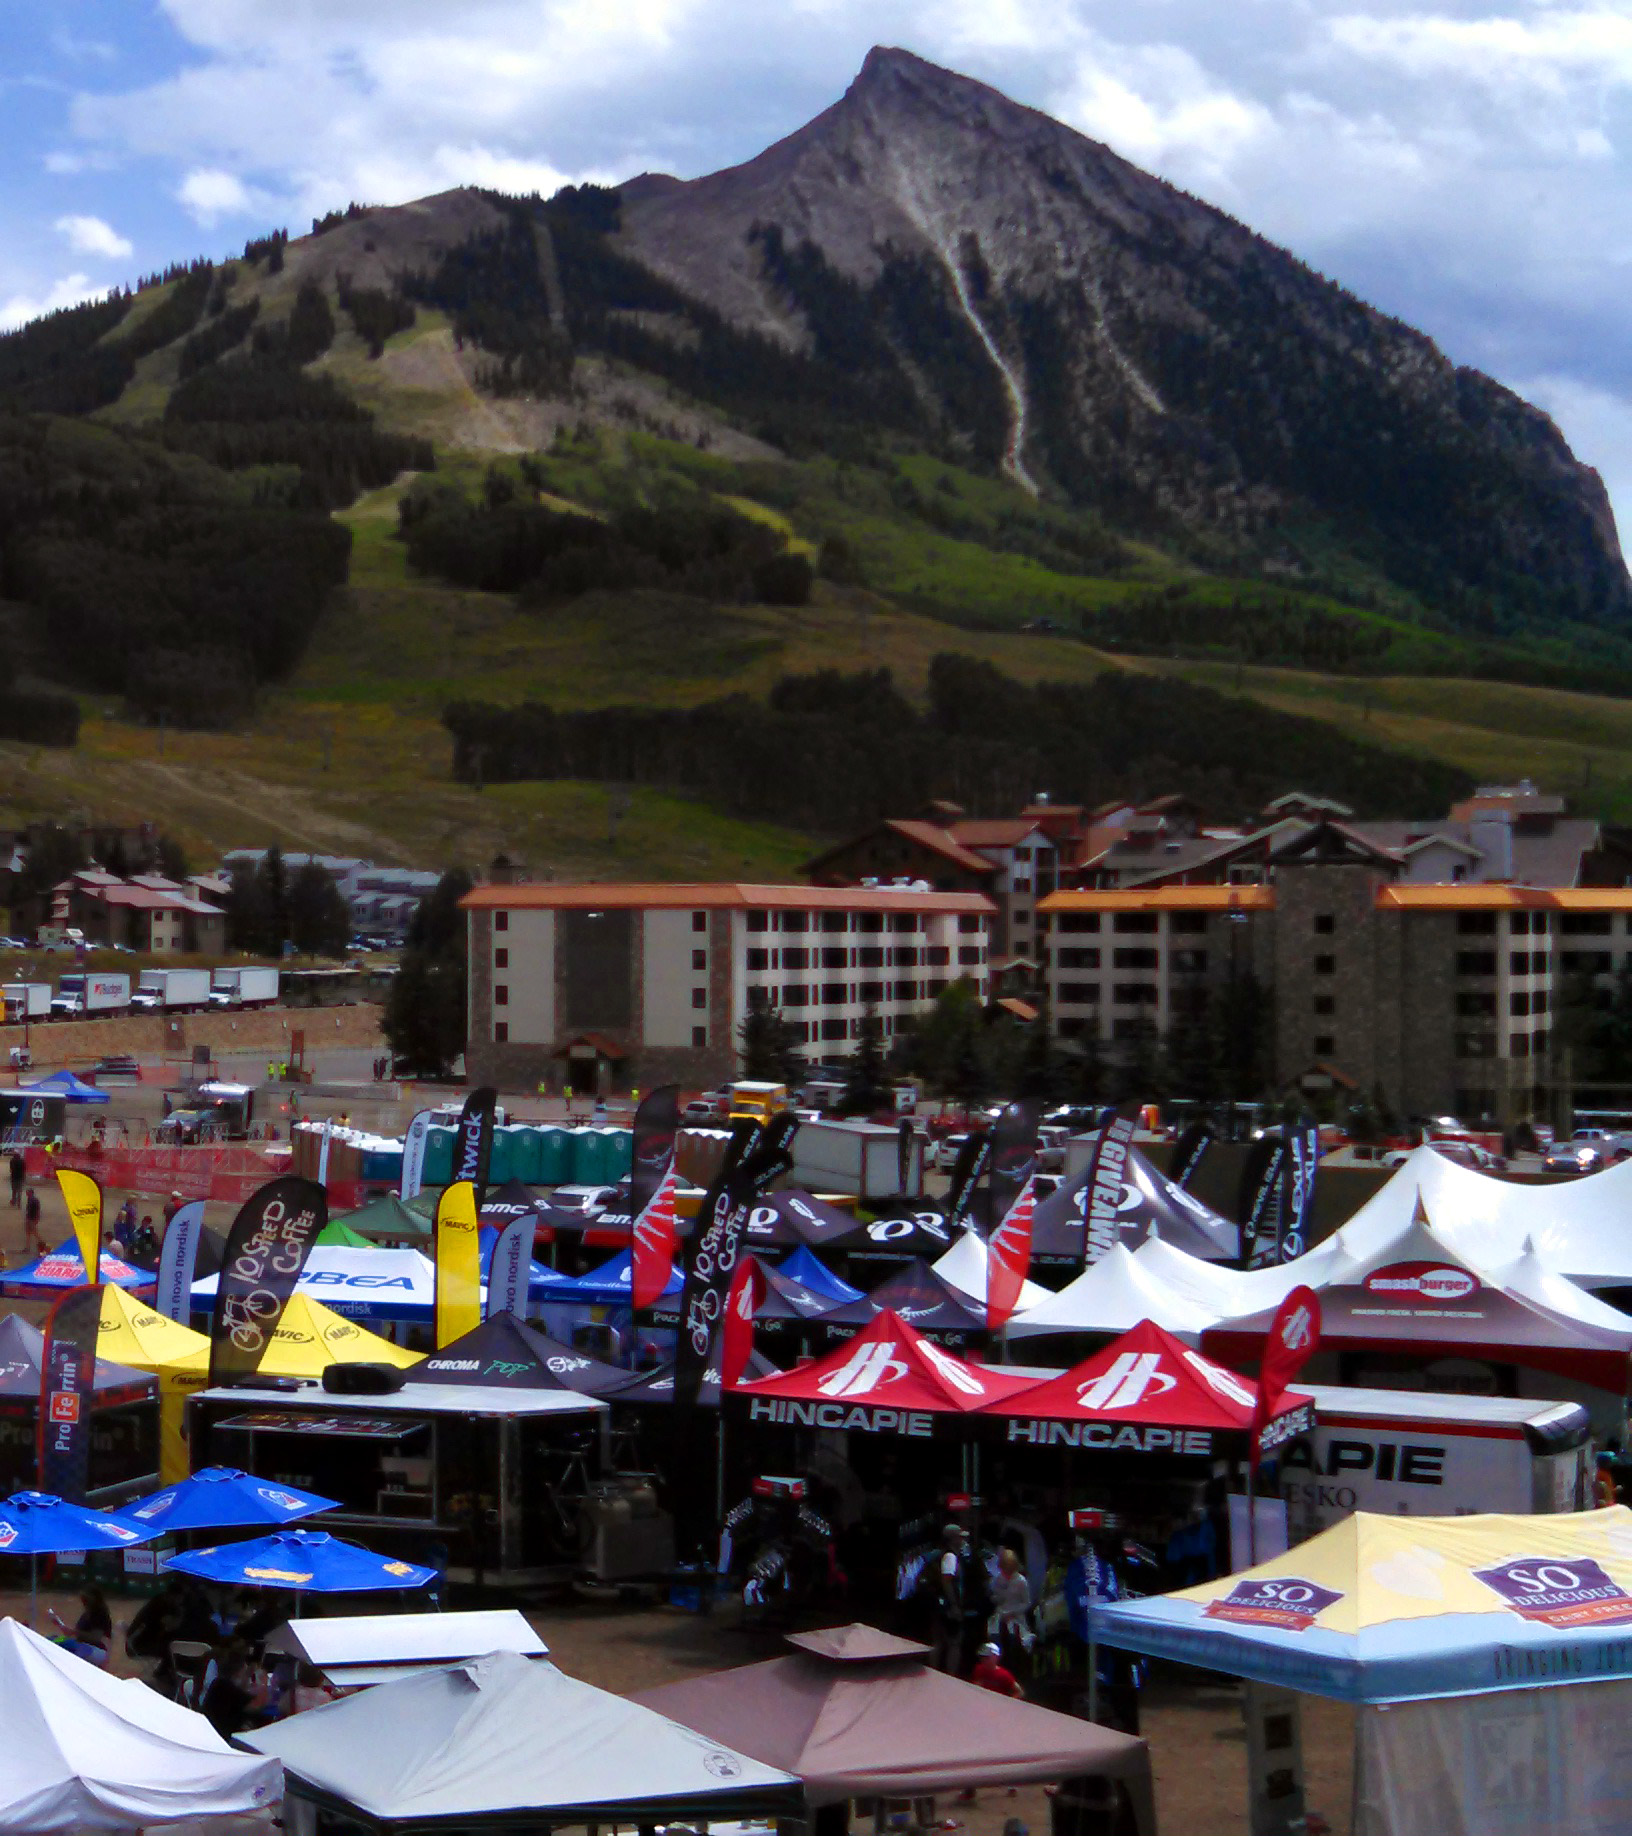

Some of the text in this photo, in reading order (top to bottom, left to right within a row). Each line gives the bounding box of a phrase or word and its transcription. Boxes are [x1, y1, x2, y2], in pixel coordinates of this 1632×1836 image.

[597, 1213, 631, 1225] BM
[176, 1220, 190, 1268] nordisk
[508, 1232, 522, 1283] nordisk
[272, 1329, 304, 1342] AVIC
[427, 1359, 481, 1371] CHROMA
[750, 1398, 934, 1439] HINCAPIE
[1008, 1419, 1213, 1456] HINCAPIE
[1507, 1566, 1581, 1593] SO
[1254, 1583, 1315, 1603] SO
[1513, 1584, 1619, 1606] DELICIOUS
